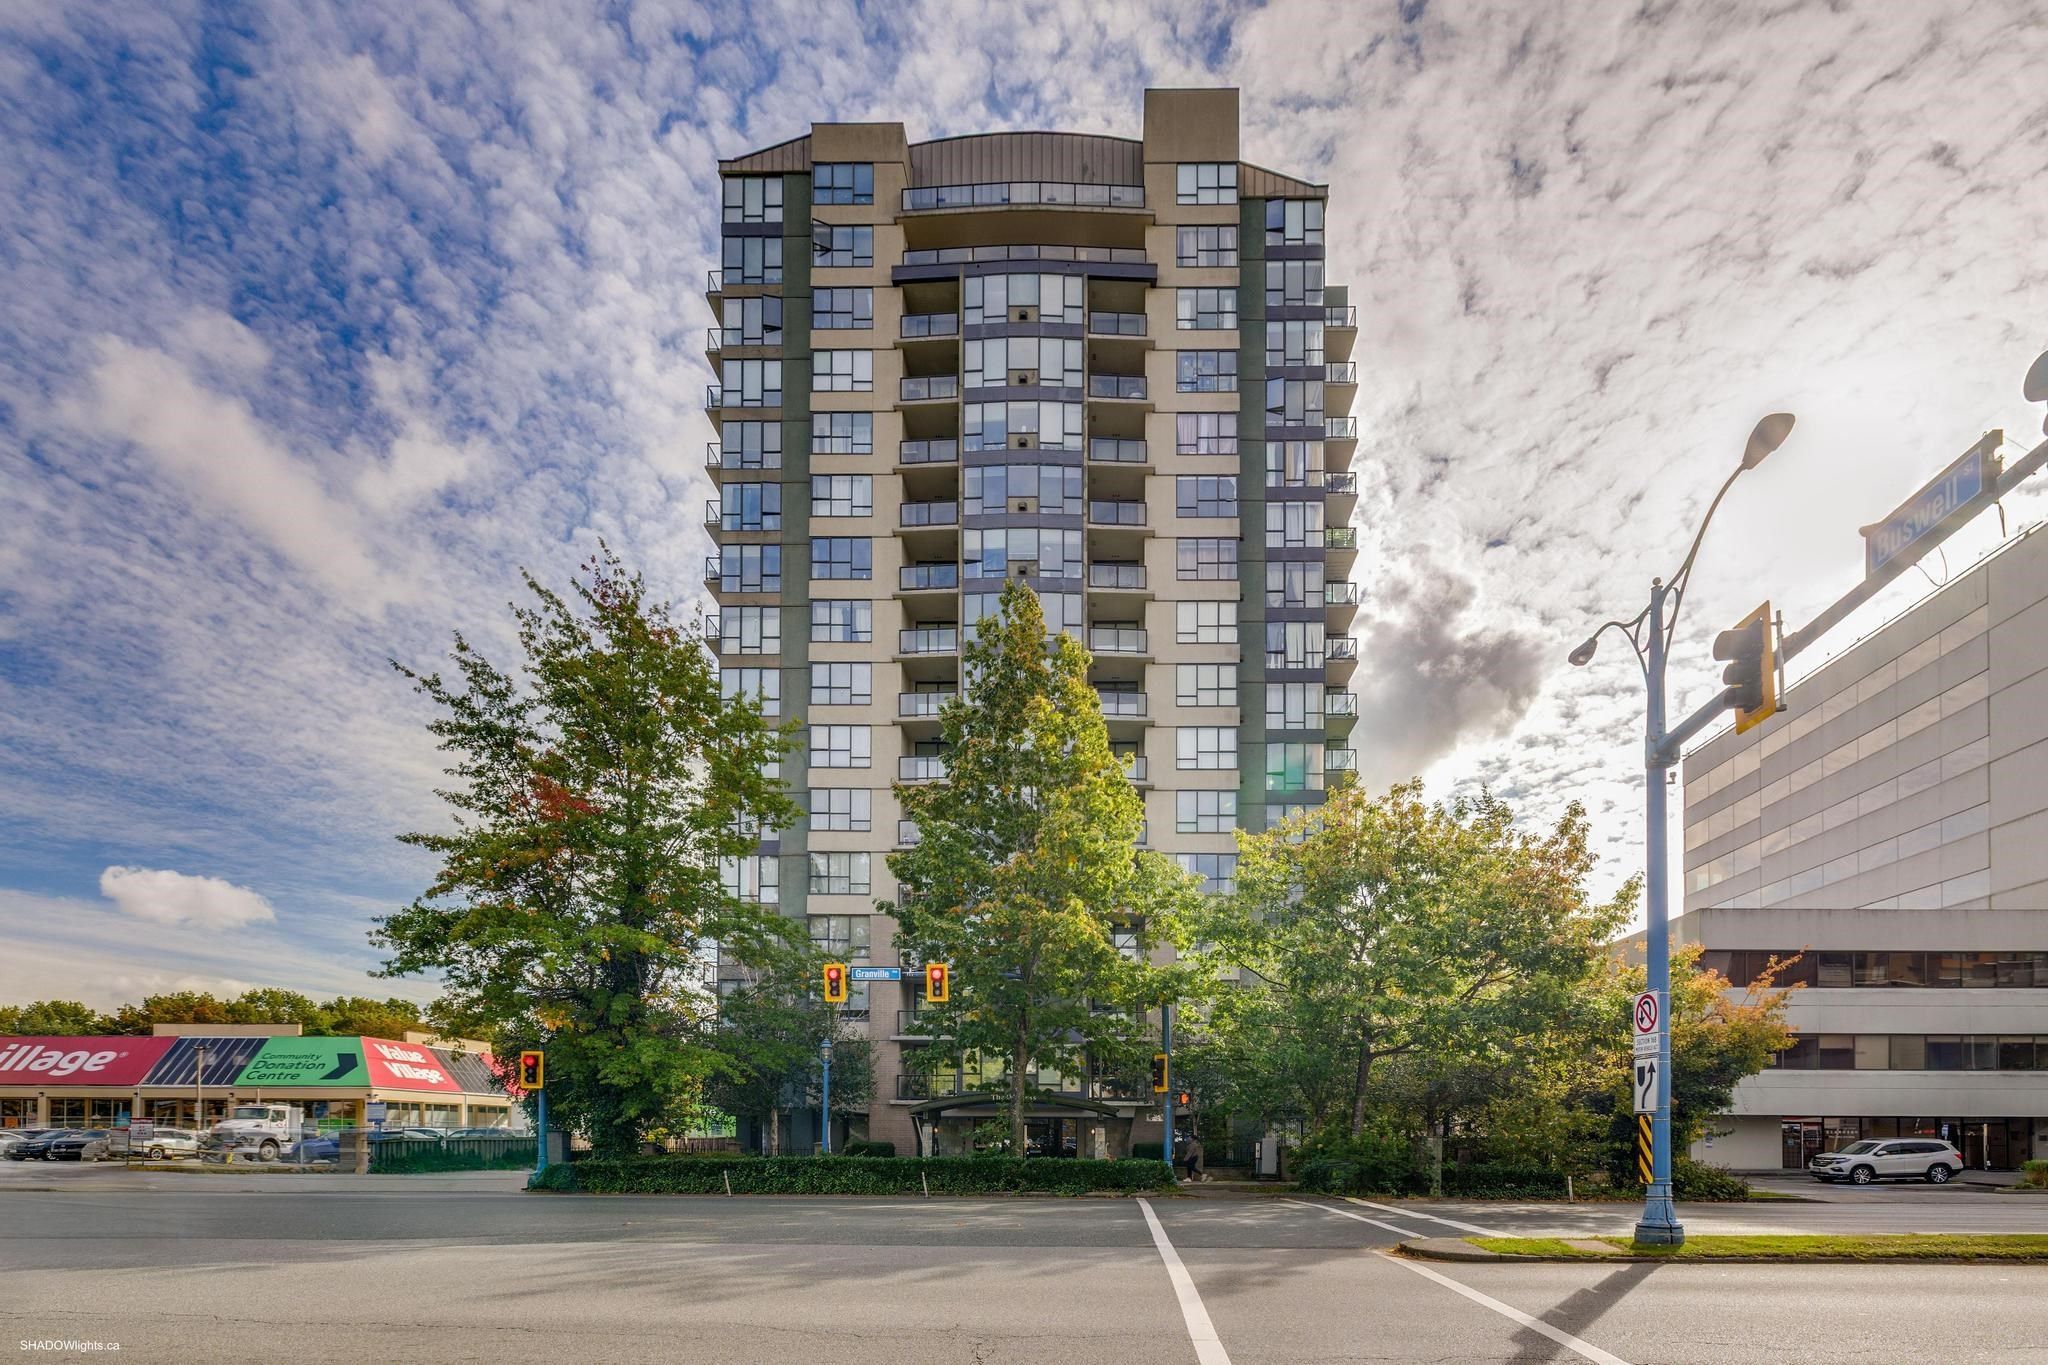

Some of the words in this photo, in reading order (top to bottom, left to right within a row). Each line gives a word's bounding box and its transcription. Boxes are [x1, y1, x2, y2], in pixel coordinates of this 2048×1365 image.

[1877, 475, 1958, 563] Buswell
[855, 969, 890, 978] Granville
[262, 1053, 322, 1061] Community
[373, 1043, 427, 1064] Value
[252, 1060, 326, 1070] Donation
[246, 1070, 300, 1080] Centre
[383, 1061, 445, 1084] Village
